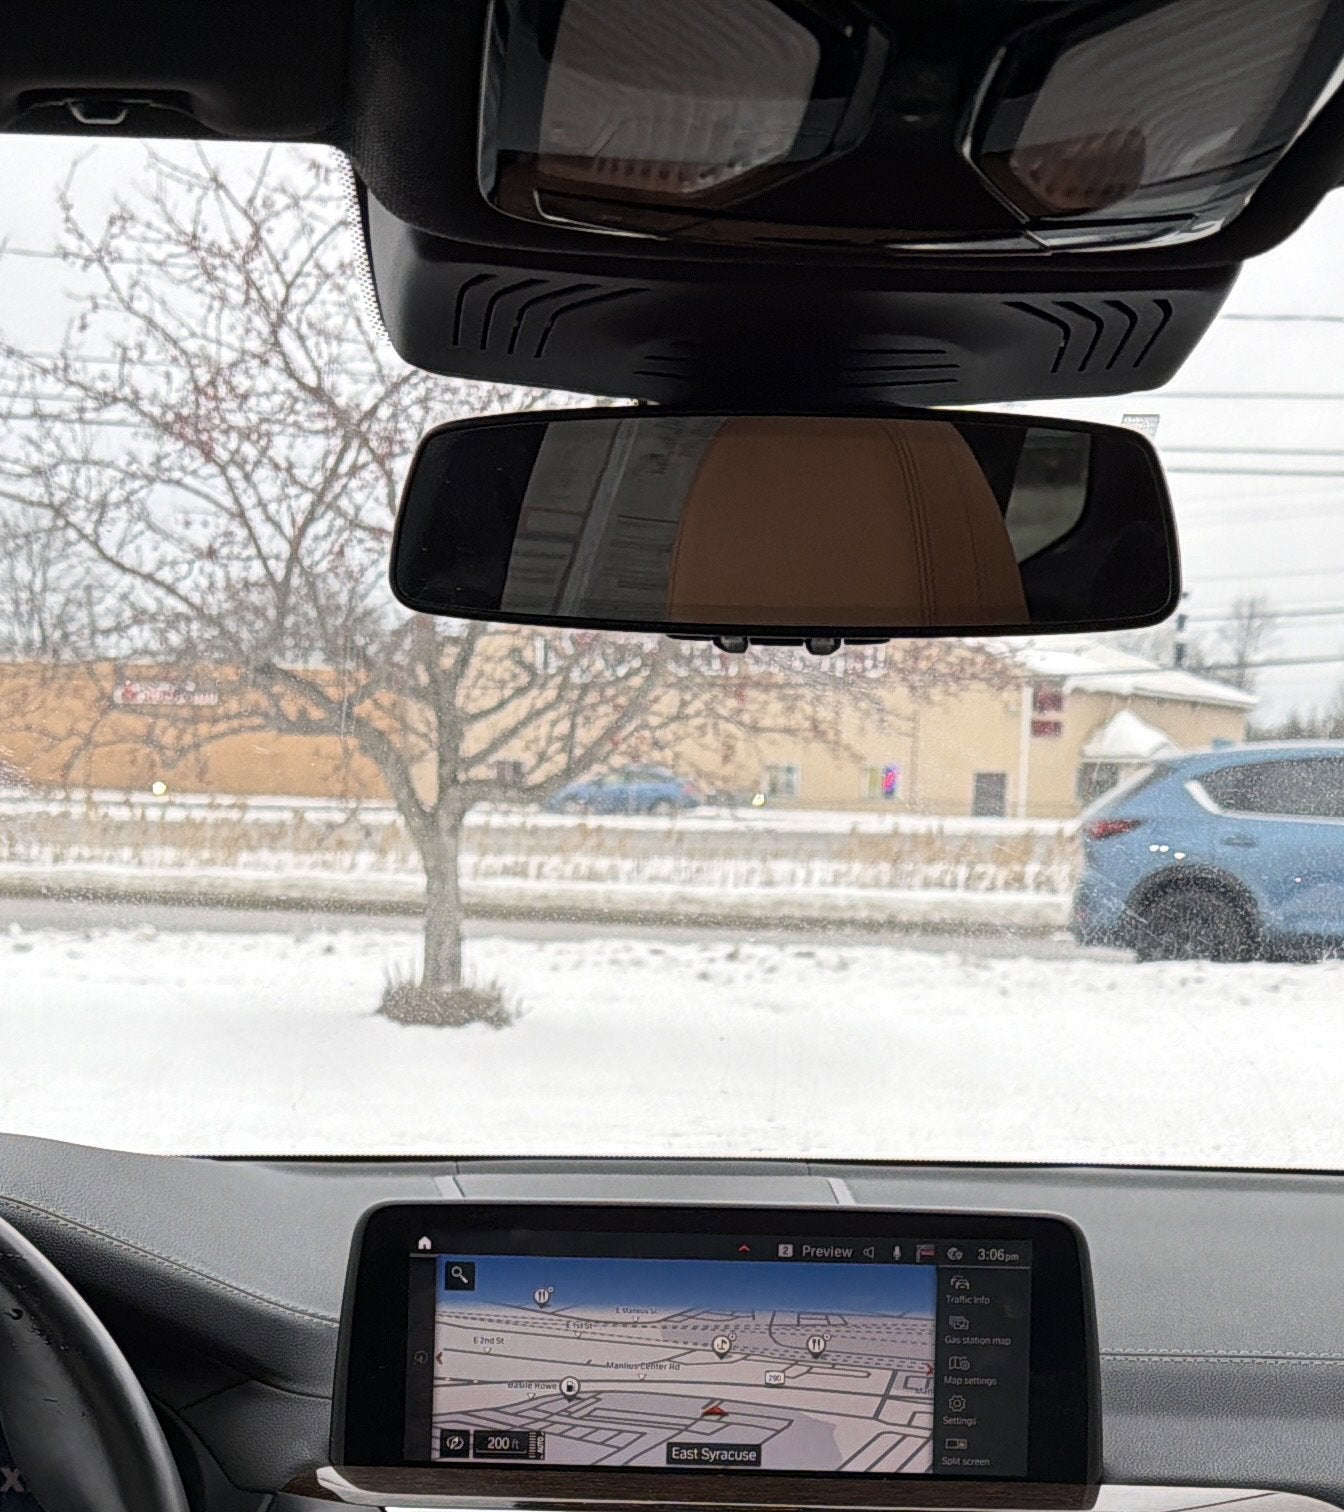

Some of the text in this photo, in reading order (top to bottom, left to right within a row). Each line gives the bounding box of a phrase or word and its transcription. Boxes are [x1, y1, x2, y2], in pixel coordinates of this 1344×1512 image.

[802, 1244, 854, 1259] Preview
[946, 1294, 971, 1304] Traffic
[479, 1336, 494, 1345] 2nd
[495, 1337, 505, 1345] St
[945, 1335, 1012, 1348] Gas station map
[606, 1361, 681, 1372] Manlius Center Rd
[768, 1374, 783, 1383] 290
[944, 1375, 997, 1387] Map settings
[943, 1416, 977, 1428] Settings
[487, 1436, 511, 1450] 200
[511, 1437, 521, 1450] ft
[671, 1446, 757, 1464] East Syracuse
[942, 1456, 991, 1468] Split screen
